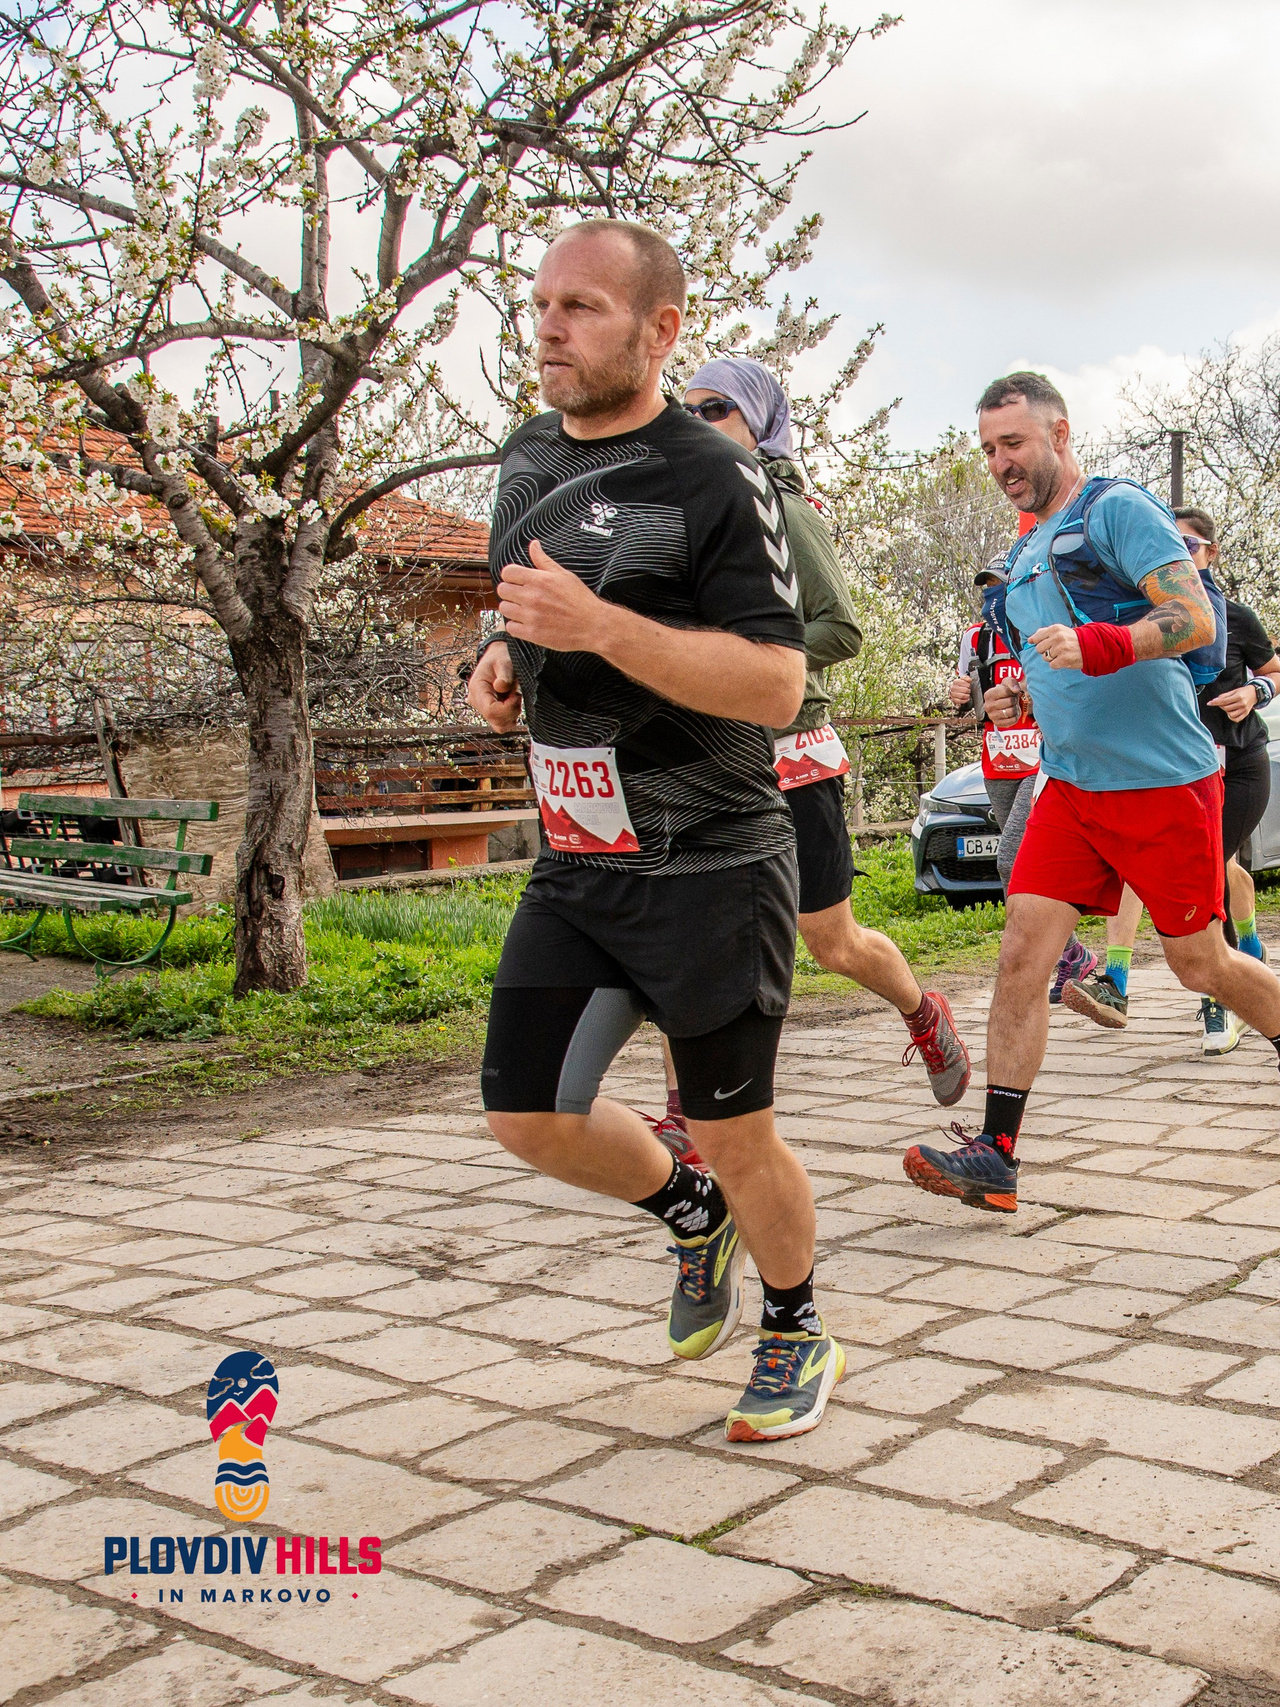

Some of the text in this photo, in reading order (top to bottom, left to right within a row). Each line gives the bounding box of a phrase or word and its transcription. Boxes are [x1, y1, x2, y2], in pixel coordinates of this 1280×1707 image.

[580, 521, 613, 537] hummel
[999, 665, 1023, 680] Fly
[1004, 734, 1038, 750] 2384
[545, 758, 615, 798] 2263
[966, 839, 983, 855] CB
